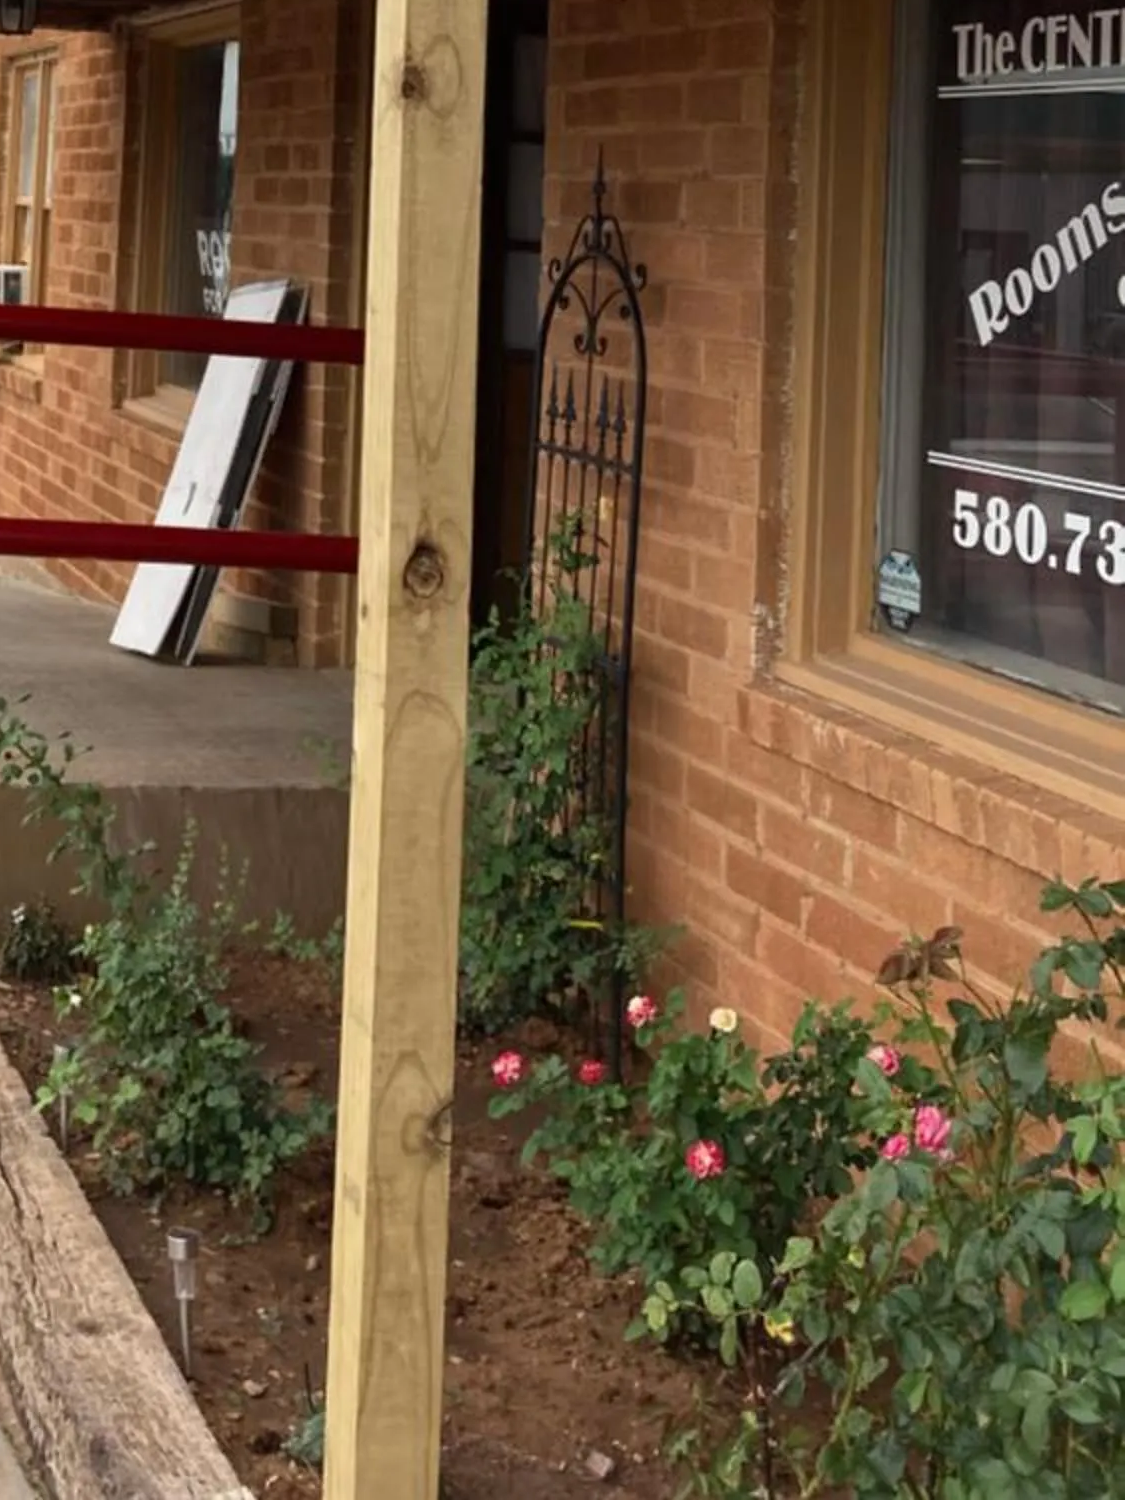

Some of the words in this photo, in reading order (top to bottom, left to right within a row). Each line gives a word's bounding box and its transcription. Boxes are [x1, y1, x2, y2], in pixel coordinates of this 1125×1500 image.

[951, 21, 1016, 78] The
[1020, 7, 1125, 74] CENT
[952, 487, 1125, 586] 580.73
